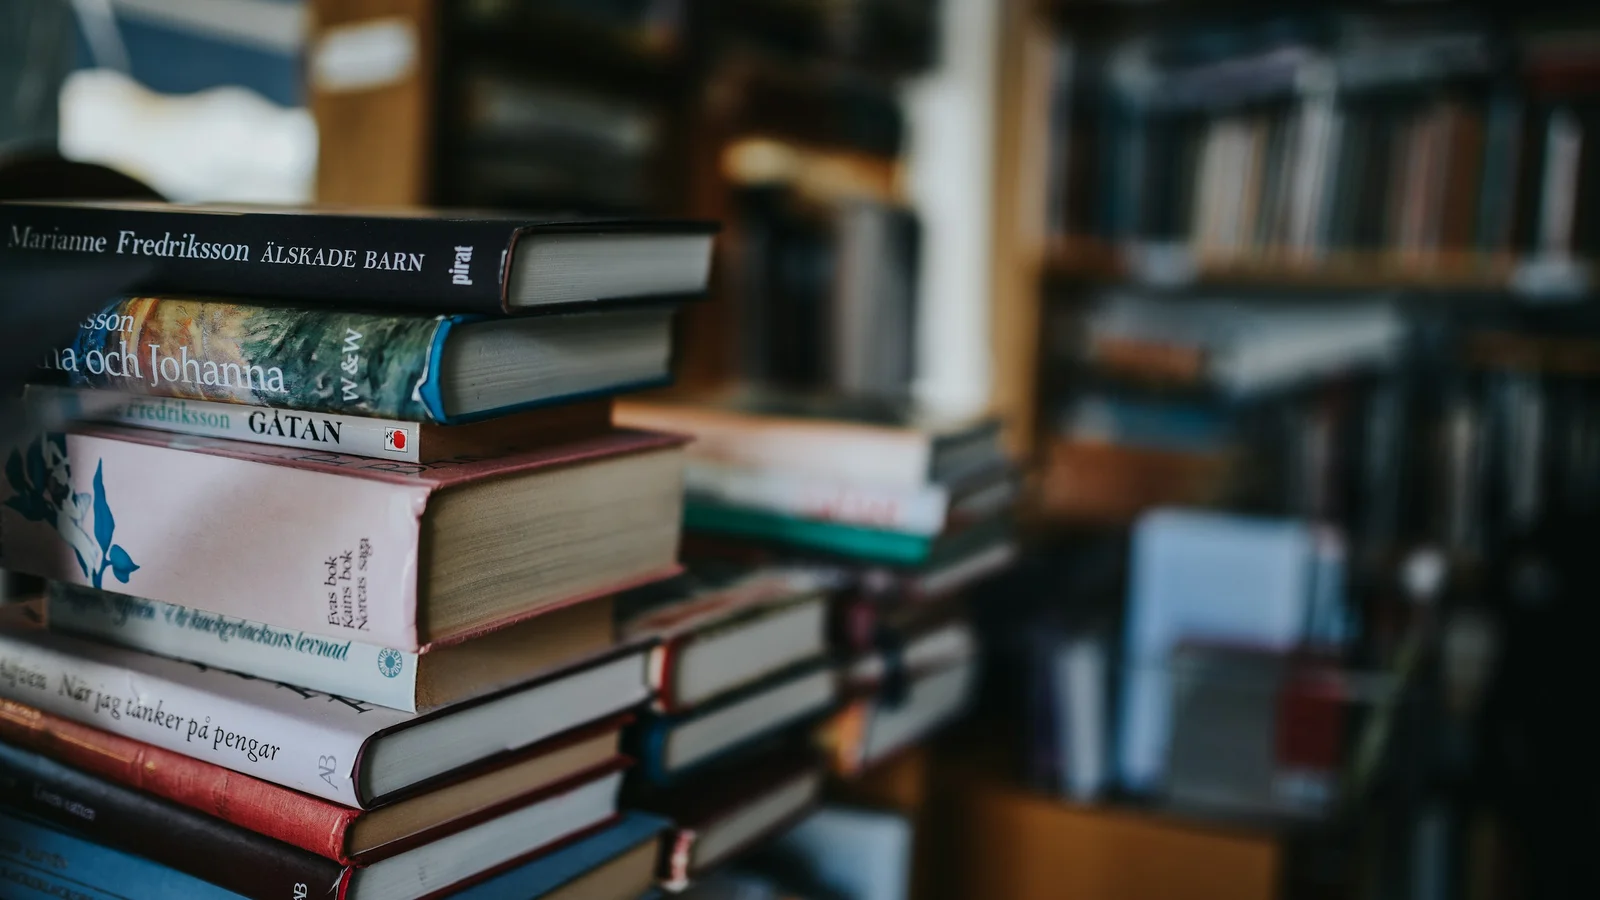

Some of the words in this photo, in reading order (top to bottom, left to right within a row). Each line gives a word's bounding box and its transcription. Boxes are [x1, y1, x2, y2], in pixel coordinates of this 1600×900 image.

[8, 224, 107, 253] Marianne
[116, 230, 250, 262] Fredriksson
[260, 241, 357, 269] ÄLSKADE
[364, 251, 425, 272] BARN
[448, 245, 473, 286] pirat
[80, 312, 134, 332] sson
[85, 340, 144, 379] och
[148, 342, 290, 393] Johanna
[127, 400, 230, 429] Fredriksson
[247, 411, 343, 444] GÅTAN
[324, 556, 337, 586] bok
[338, 550, 353, 580] bok
[328, 592, 340, 625] Evas
[341, 586, 355, 629] Kains
[294, 631, 351, 662] levnad
[58, 671, 91, 703] När
[93, 683, 121, 720] jag
[125, 697, 184, 732] tänker
[187, 715, 212, 742] på
[213, 726, 280, 762] pengar
[318, 755, 338, 791] AB
